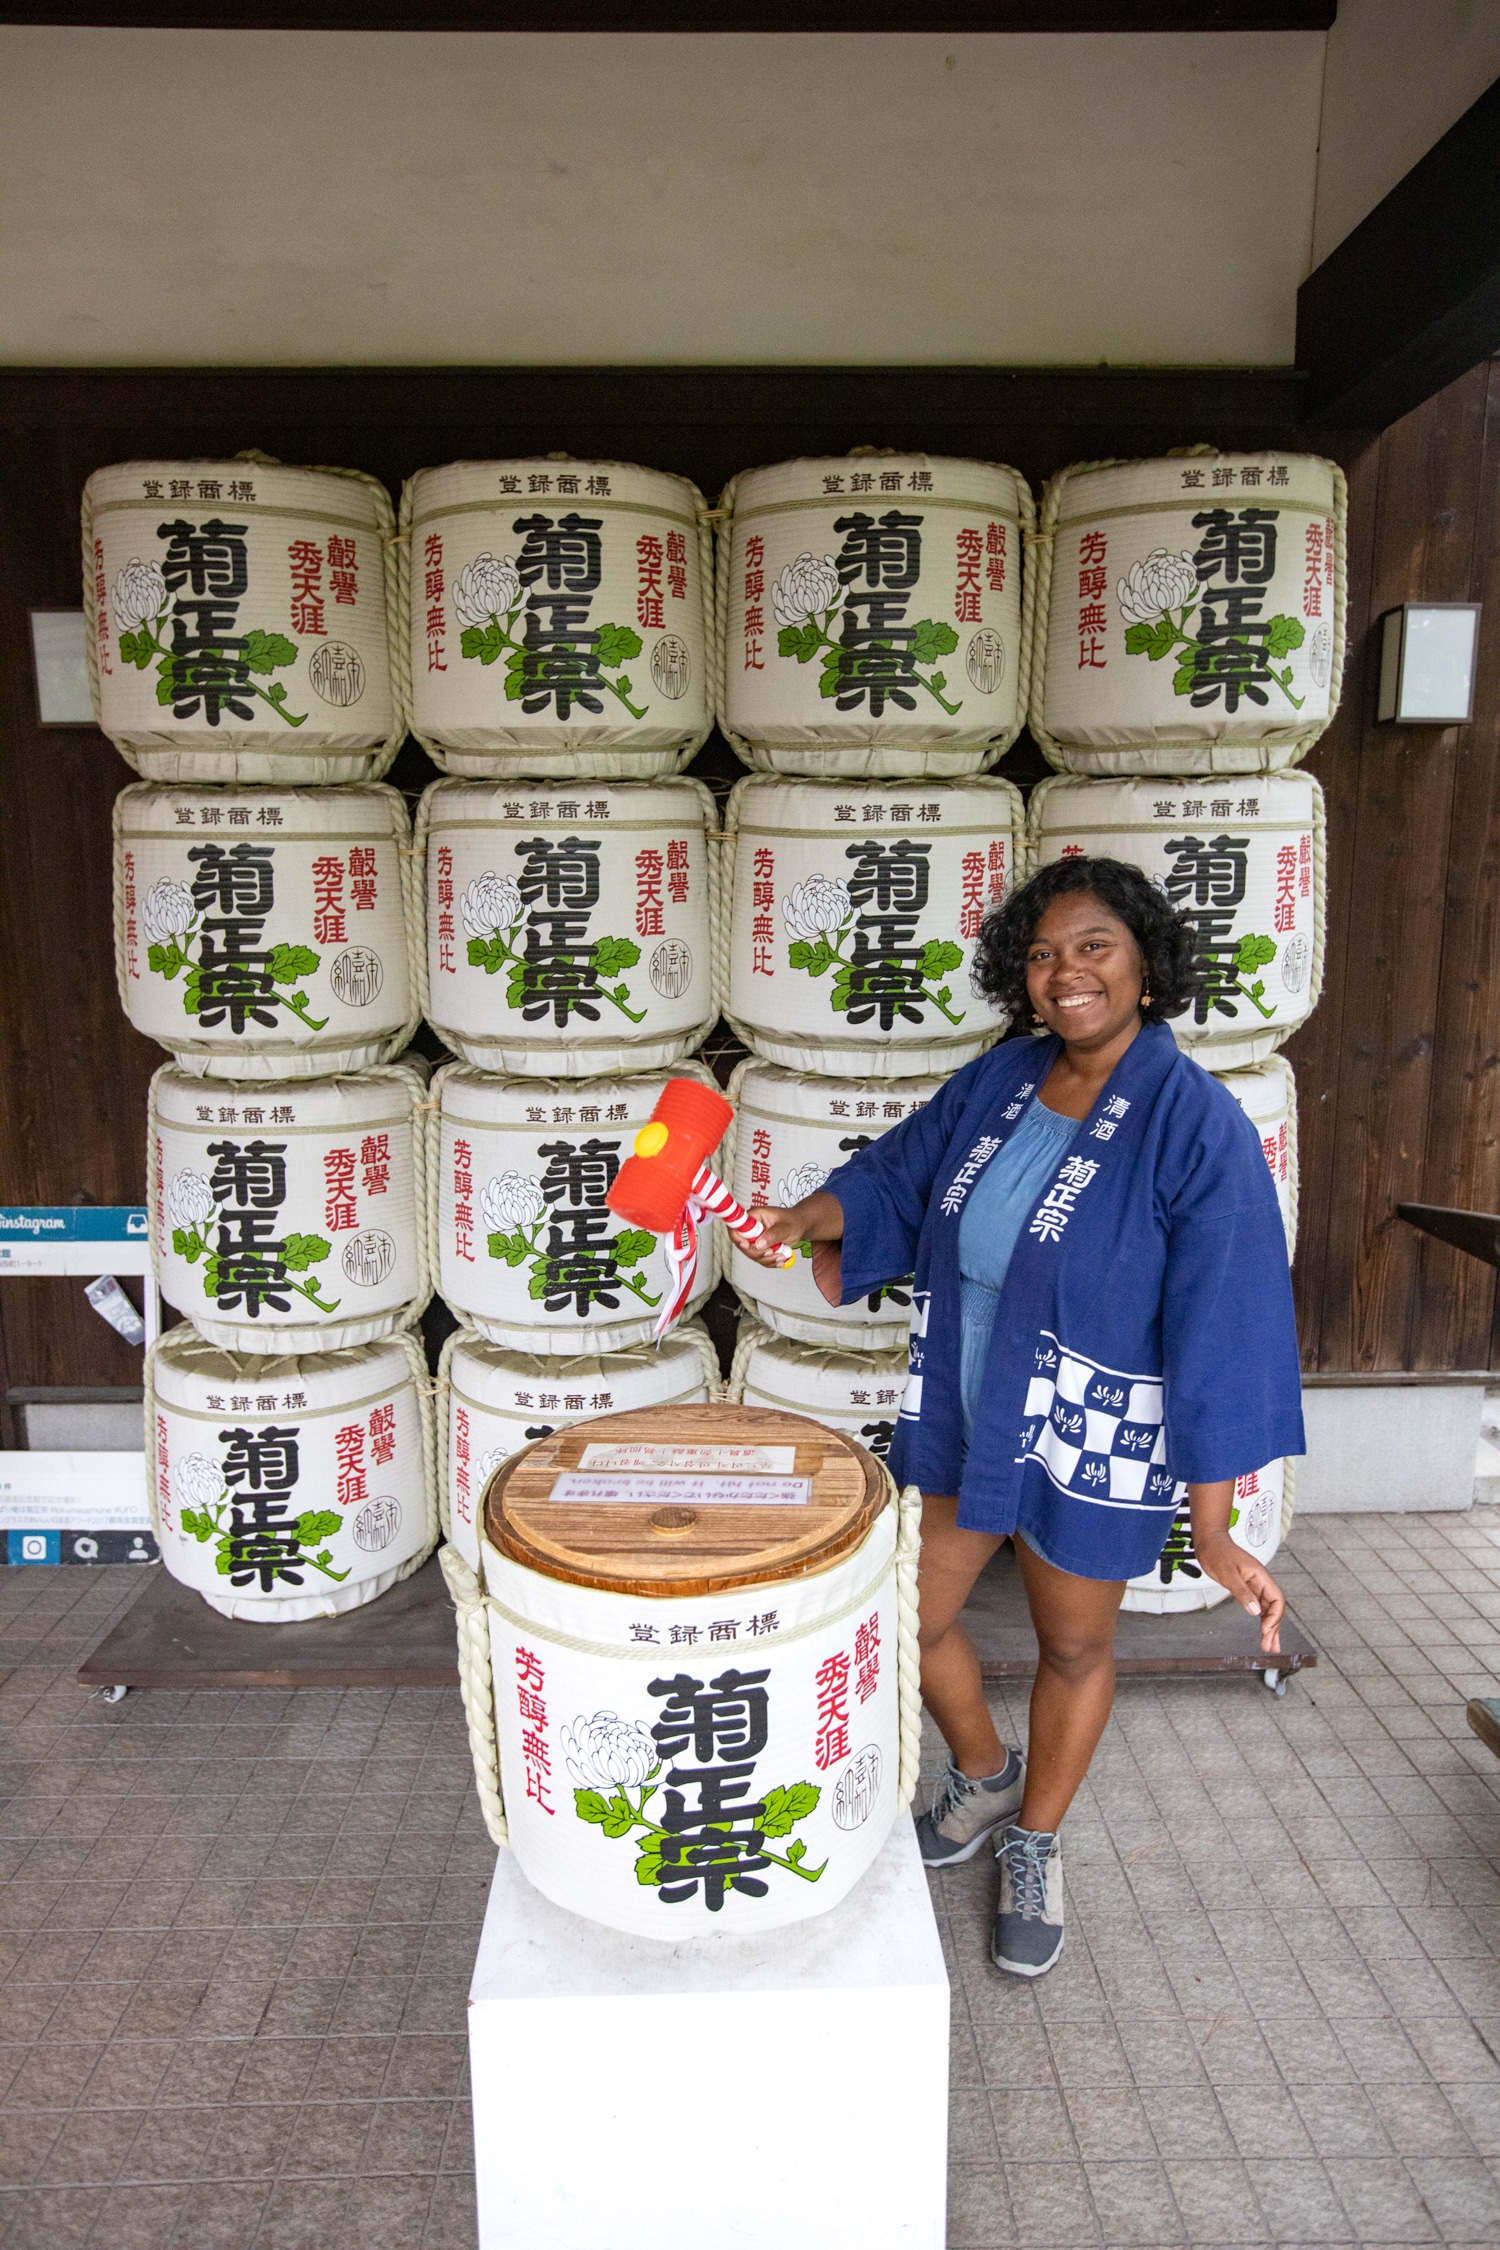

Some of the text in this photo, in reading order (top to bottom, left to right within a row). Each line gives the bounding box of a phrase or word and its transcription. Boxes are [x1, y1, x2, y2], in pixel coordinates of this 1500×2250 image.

[143, 480, 256, 501] 登録商標
[499, 474, 611, 496] 登録商標
[823, 472, 933, 495] 登録商標
[1181, 466, 1289, 488] 登録商標
[288, 540, 328, 636] 秀天涯
[425, 534, 448, 672] 芳醇無比
[636, 535, 667, 629] 秀天涯
[744, 536, 765, 670] 芳醇無比
[833, 509, 924, 718] 菊正宗
[955, 529, 983, 622] 秀天涯
[1078, 531, 1108, 669] 芳醇無比
[1190, 507, 1279, 714] 菊正宗
[1304, 524, 1325, 617] 秀天涯
[157, 517, 256, 726] 菊正宗
[511, 511, 605, 722] 菊正宗
[175, 807, 283, 825] 登録商標
[503, 801, 609, 819] 登録商標
[835, 804, 941, 822] 登録商標
[1153, 799, 1259, 817] 登録商標
[312, 857, 350, 944] 秀天涯
[438, 847, 456, 973] 芳醇無比
[635, 850, 665, 936] 秀天涯
[752, 849, 774, 976] 芳醇無比
[1275, 846, 1296, 932] 秀天涯
[187, 843, 279, 1035] 菊正宗
[516, 836, 602, 1029] 菊正宗
[846, 840, 931, 1031] 菊正宗
[196, 1106, 295, 1123] 登録商標
[526, 1104, 628, 1123] 登録商標
[1089, 1095, 1130, 1140] 清酒
[324, 1149, 359, 1232] 秀天涯
[454, 1140, 474, 1262] 芳醇無比
[941, 1136, 1001, 1216] 菊正宗
[1030, 1156, 1100, 1242] 菊正宗
[207, 1139, 291, 1318] 菊正宗
[537, 1137, 621, 1318] 菊正宗
[207, 1393, 307, 1411] 登録商標
[515, 1392, 613, 1409] 登録商標
[851, 1390, 906, 1405] 登録
[335, 1424, 371, 1505] 秀天涯
[636, 1479, 654, 1487] be
[659, 1479, 686, 1488] will
[782, 1481, 803, 1489] Do
[219, 1426, 304, 1593] 菊正宗
[630, 1611, 779, 1645] 登録商標
[516, 1648, 554, 1815] 芳醇無比
[816, 1653, 850, 1770] 秀天涯
[647, 1668, 772, 1911] 菊正宗
